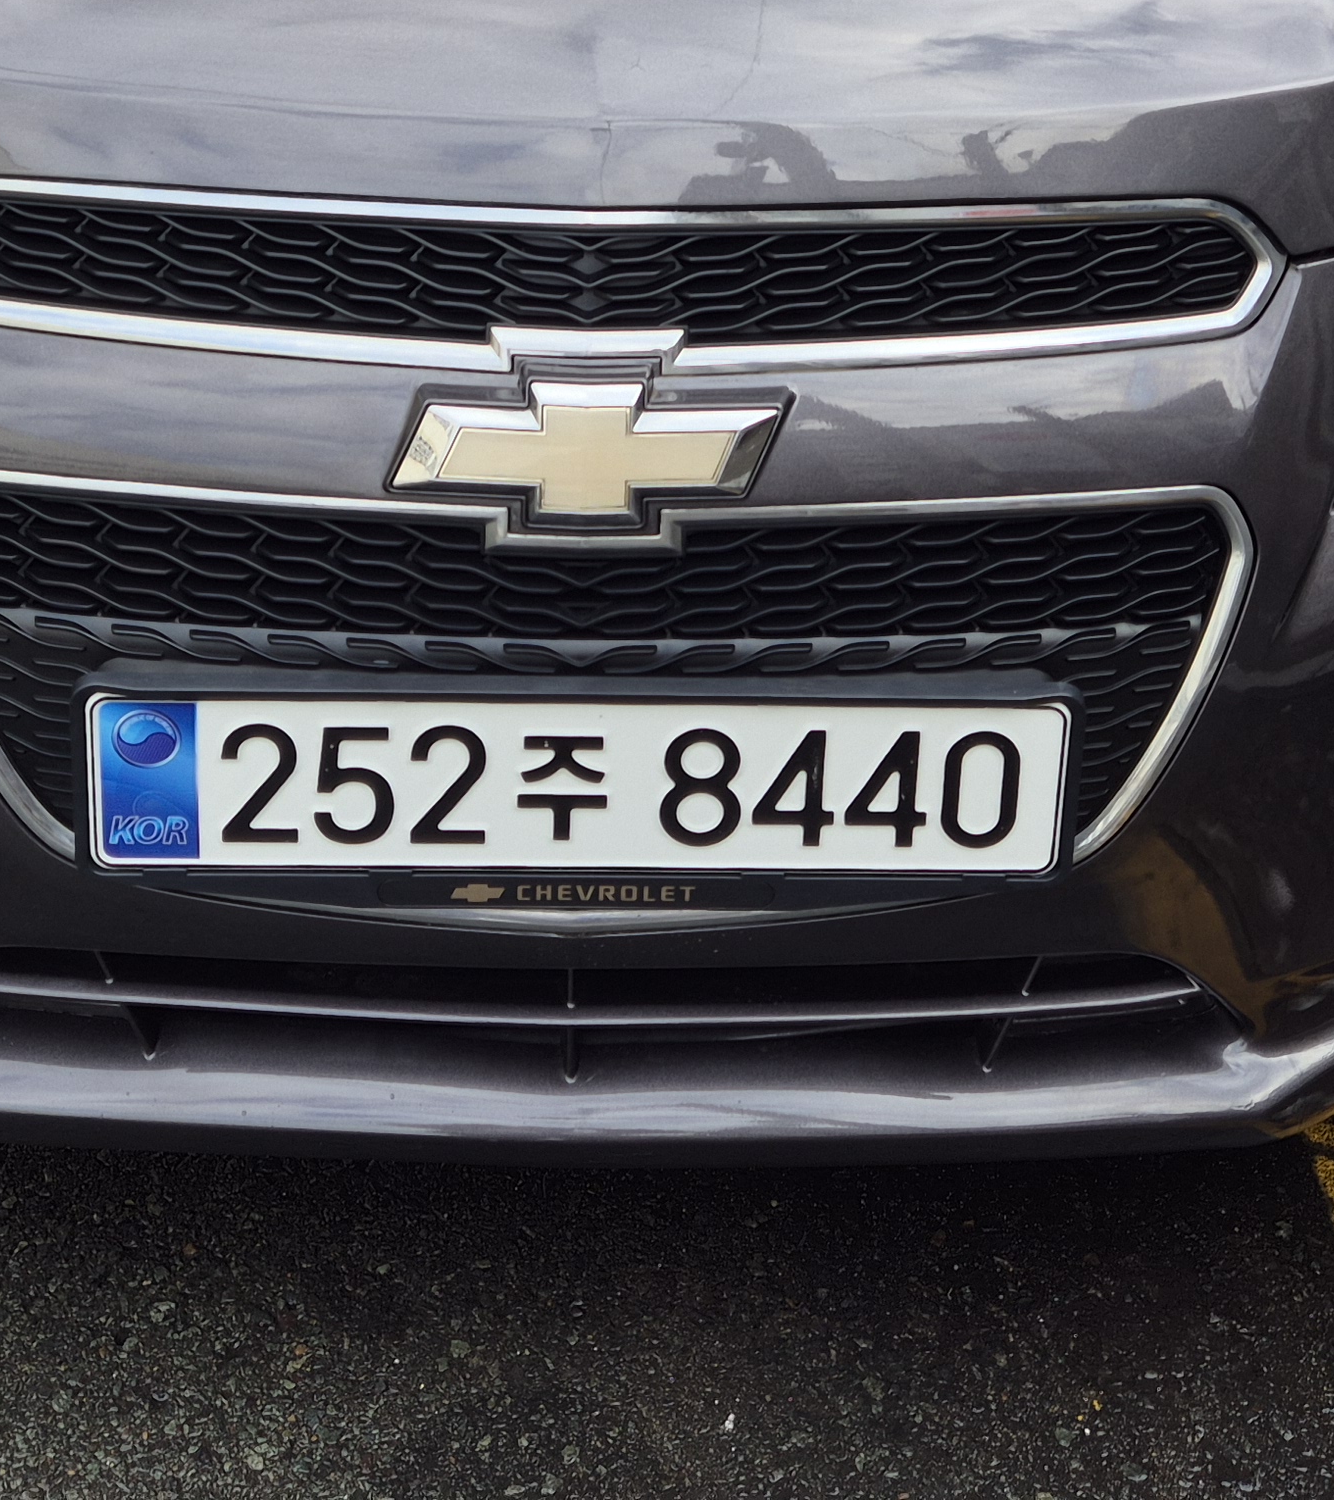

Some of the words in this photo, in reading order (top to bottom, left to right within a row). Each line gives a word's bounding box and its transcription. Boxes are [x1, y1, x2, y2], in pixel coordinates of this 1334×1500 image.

[221, 723, 608, 844] 252주
[659, 728, 1021, 849] 8440
[109, 815, 189, 845] KOR
[517, 885, 696, 902] CHEVROLET
